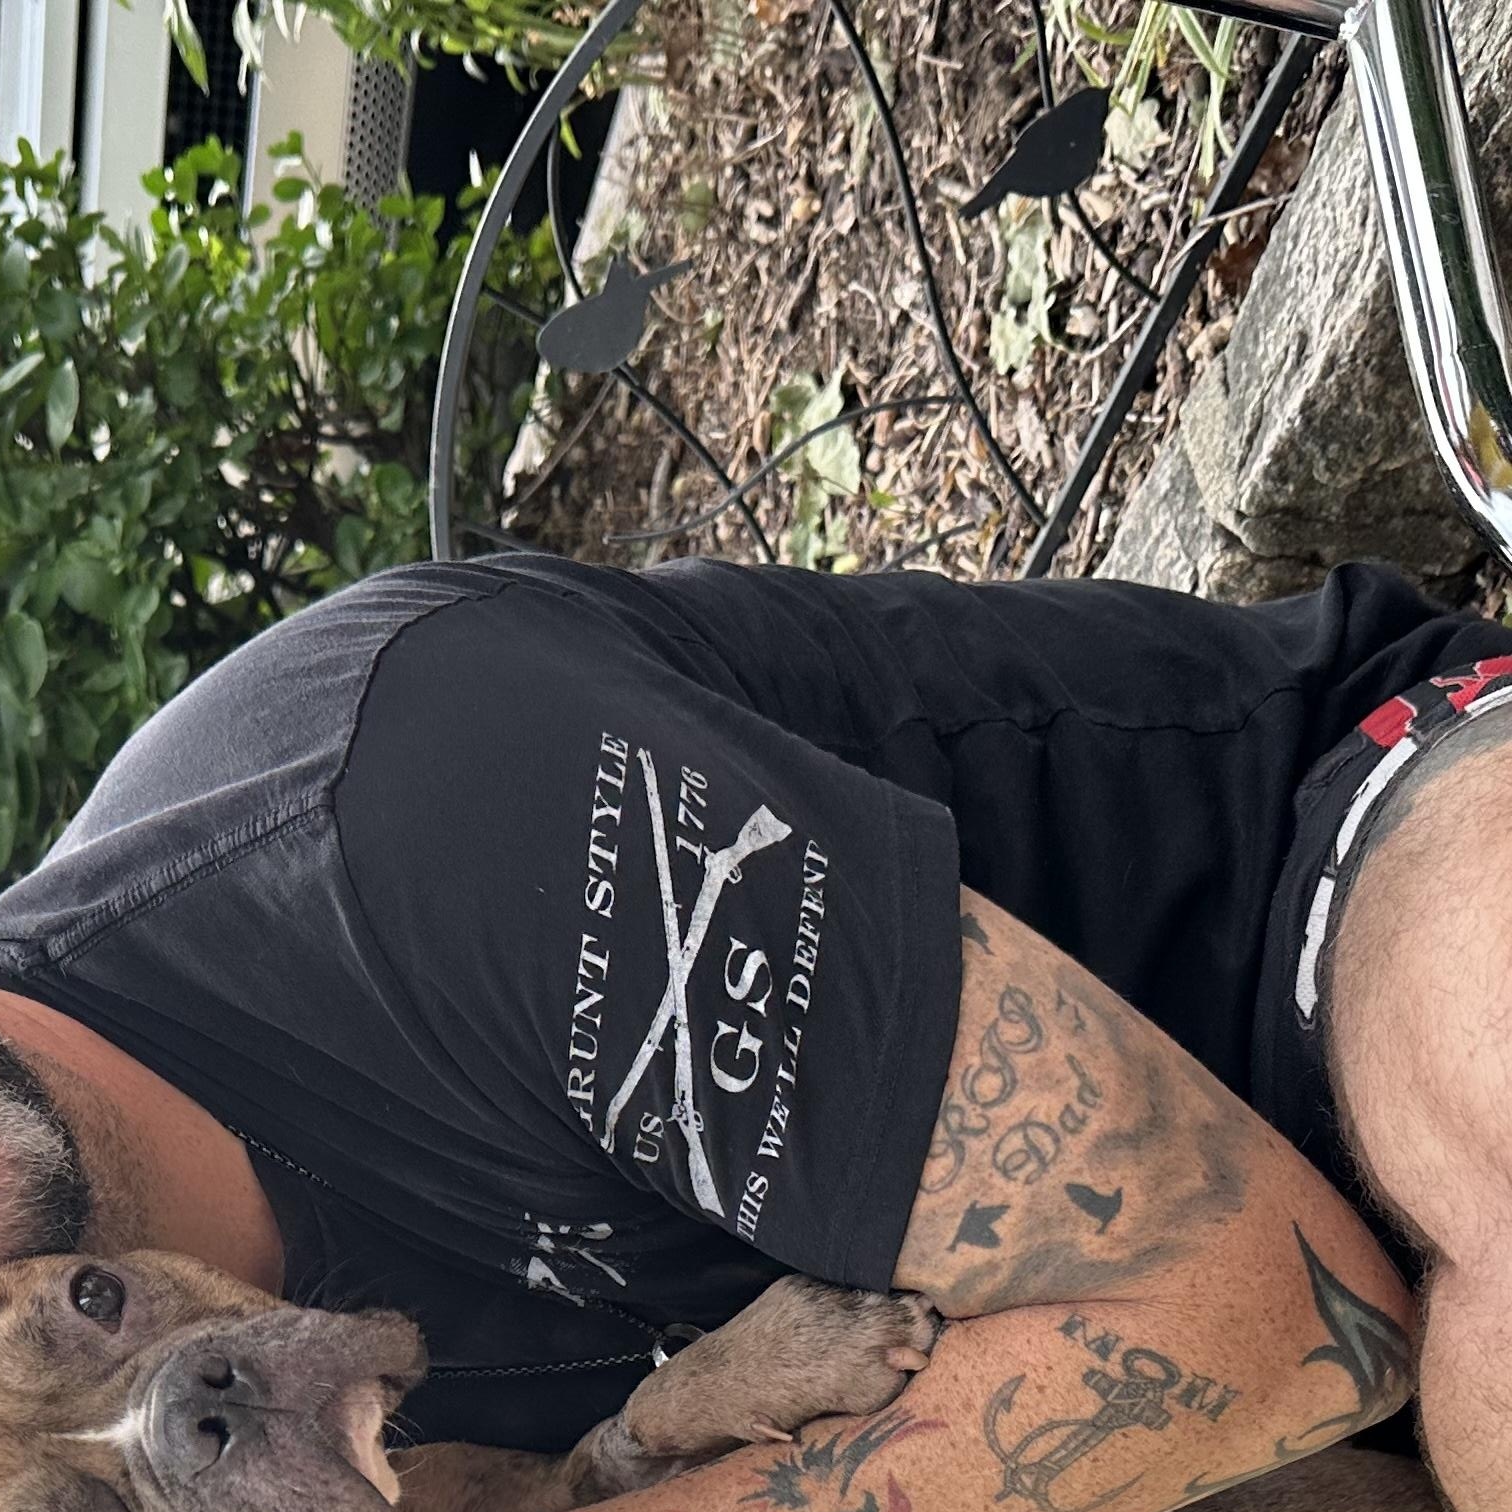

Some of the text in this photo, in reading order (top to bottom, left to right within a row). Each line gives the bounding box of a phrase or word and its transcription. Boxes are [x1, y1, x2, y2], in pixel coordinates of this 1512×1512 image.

[585, 732, 629, 918] STYLE
[676, 766, 709, 864] 1776
[710, 937, 773, 1093] GS
[633, 1111, 665, 1163] US
[736, 1172, 769, 1243] THIS
[756, 1022, 801, 1160] WE'LL
